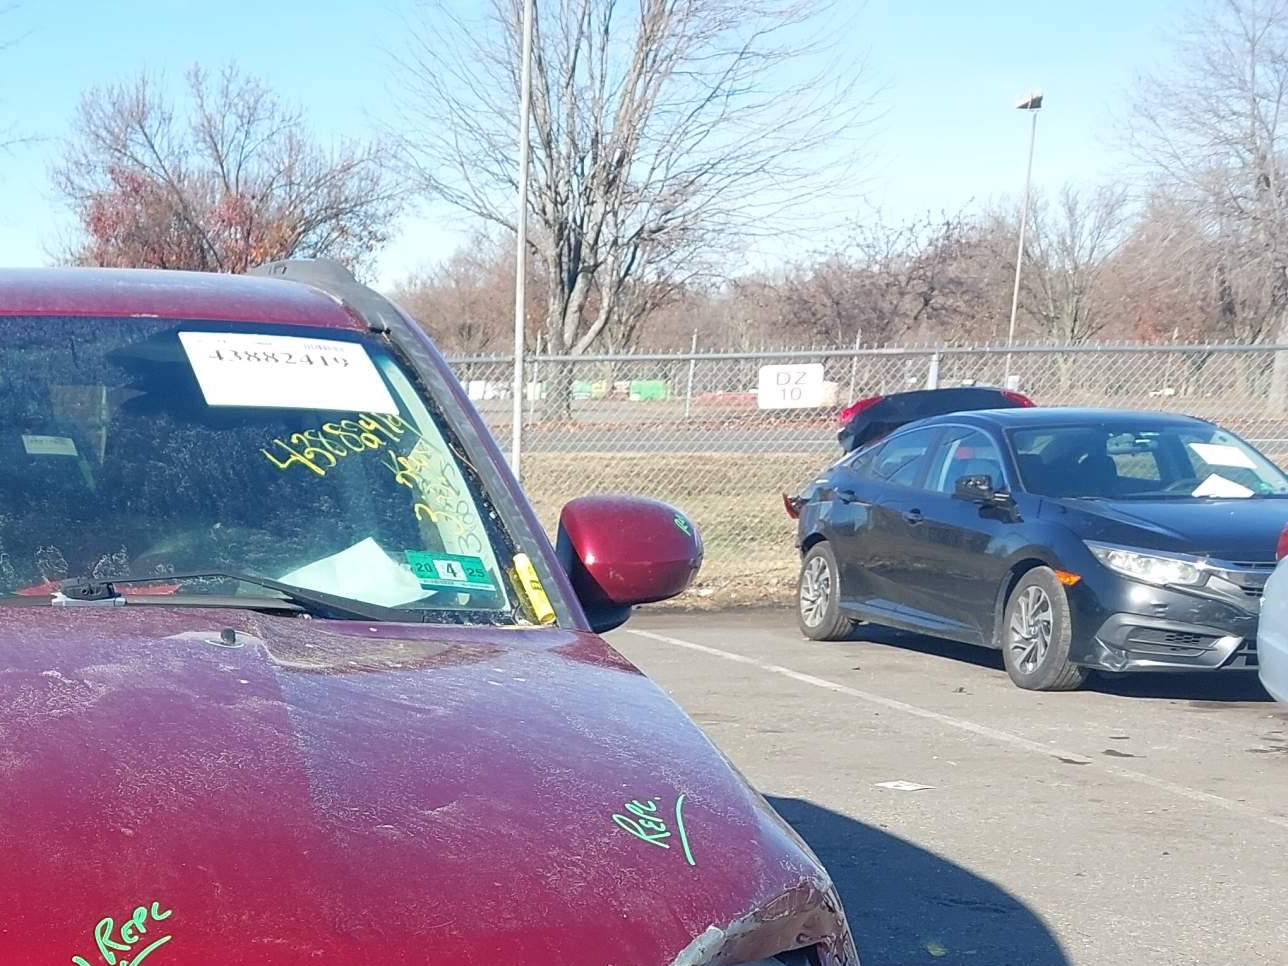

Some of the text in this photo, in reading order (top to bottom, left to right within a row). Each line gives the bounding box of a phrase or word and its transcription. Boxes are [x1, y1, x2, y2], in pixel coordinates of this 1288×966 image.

[776, 371, 808, 386] DZ
[779, 387, 803, 401] 10
[415, 562, 486, 578] 20 4 25
